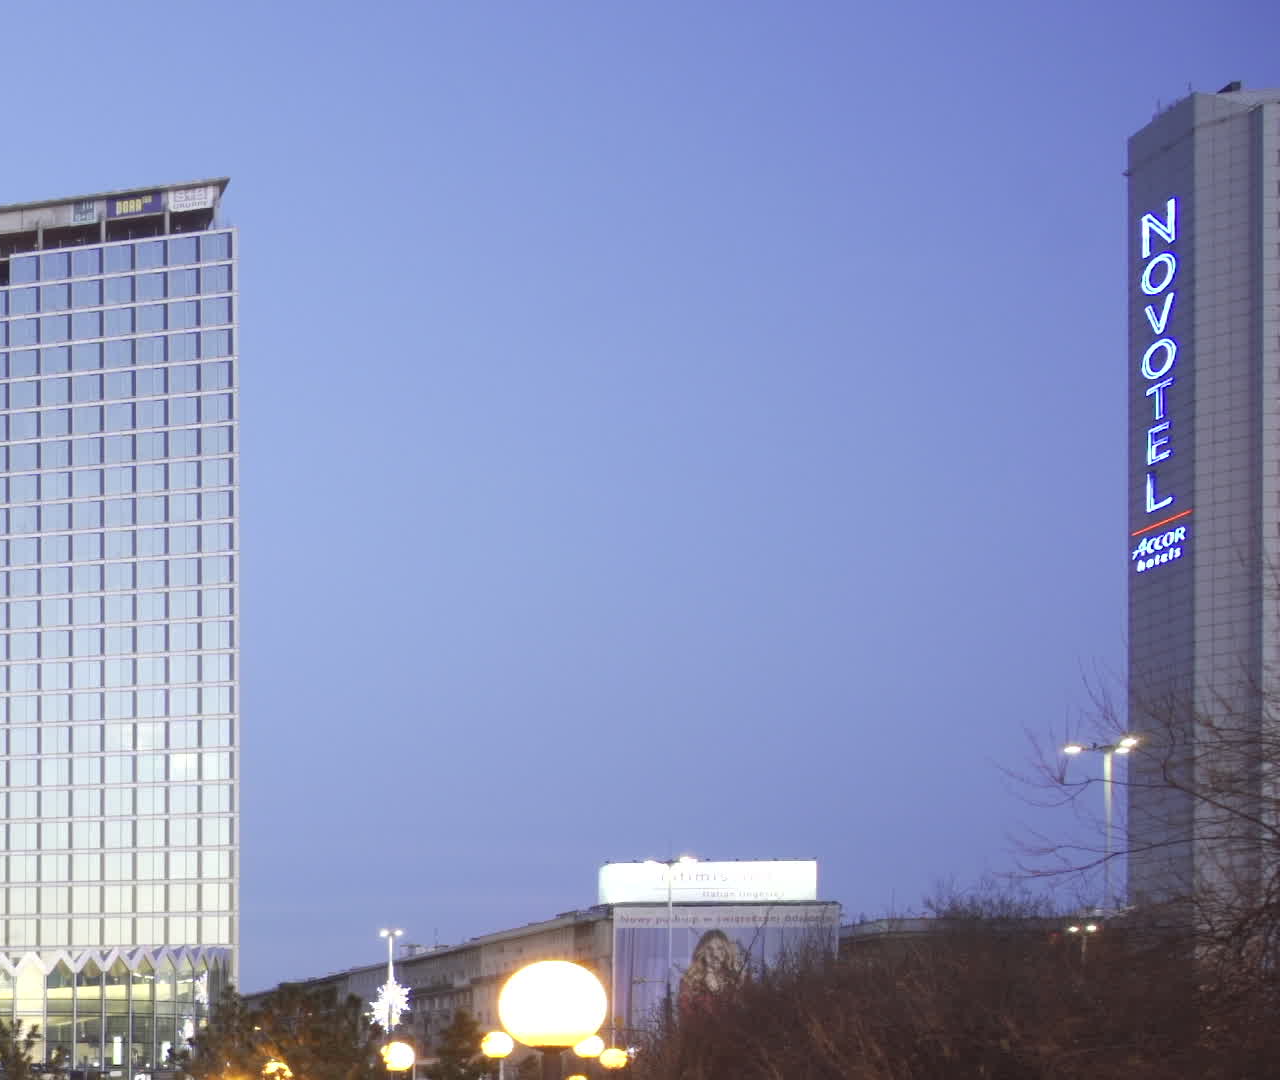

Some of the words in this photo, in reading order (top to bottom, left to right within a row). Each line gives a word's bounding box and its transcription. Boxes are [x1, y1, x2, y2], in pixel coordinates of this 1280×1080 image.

[1141, 197, 1177, 513] NOVOTEL
[1132, 526, 1186, 560] ACCOR
[1136, 547, 1181, 573] hotels
